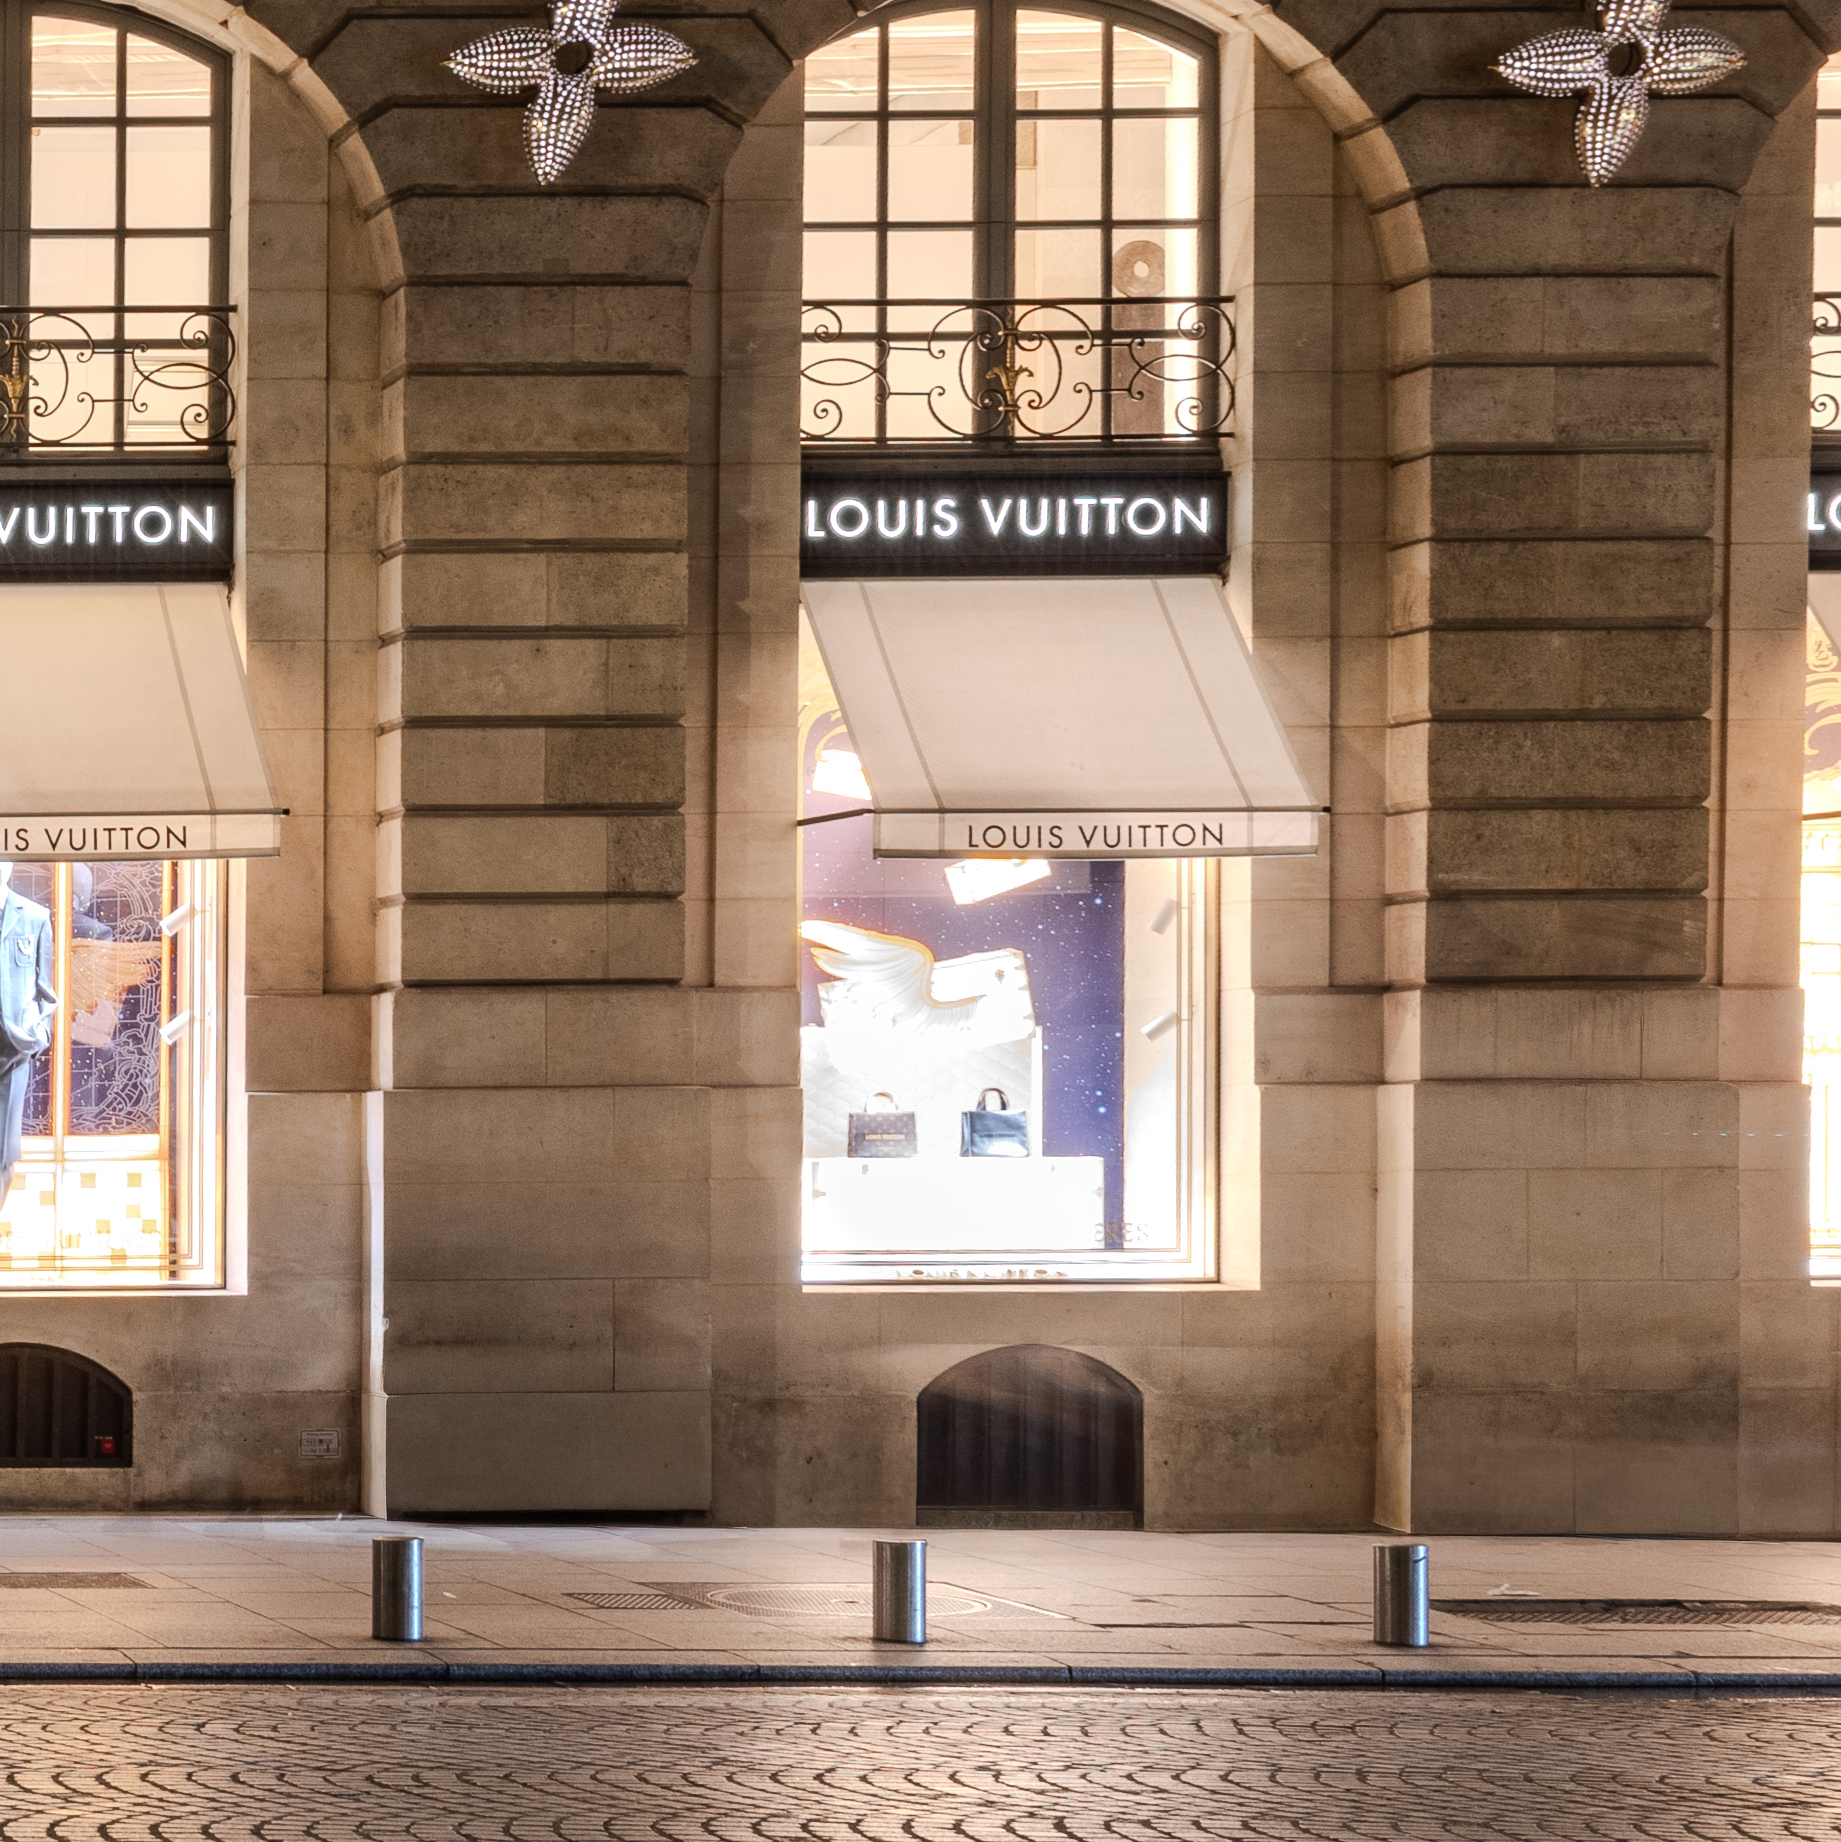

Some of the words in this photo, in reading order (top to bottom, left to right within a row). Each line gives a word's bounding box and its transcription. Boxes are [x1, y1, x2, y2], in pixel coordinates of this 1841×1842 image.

[806, 498, 959, 539] LOUIS
[980, 497, 1210, 538] VUITTON
[44, 825, 187, 852] VUITTON
[968, 824, 1063, 849] LOUIS
[1078, 823, 1223, 849] VUITTON
